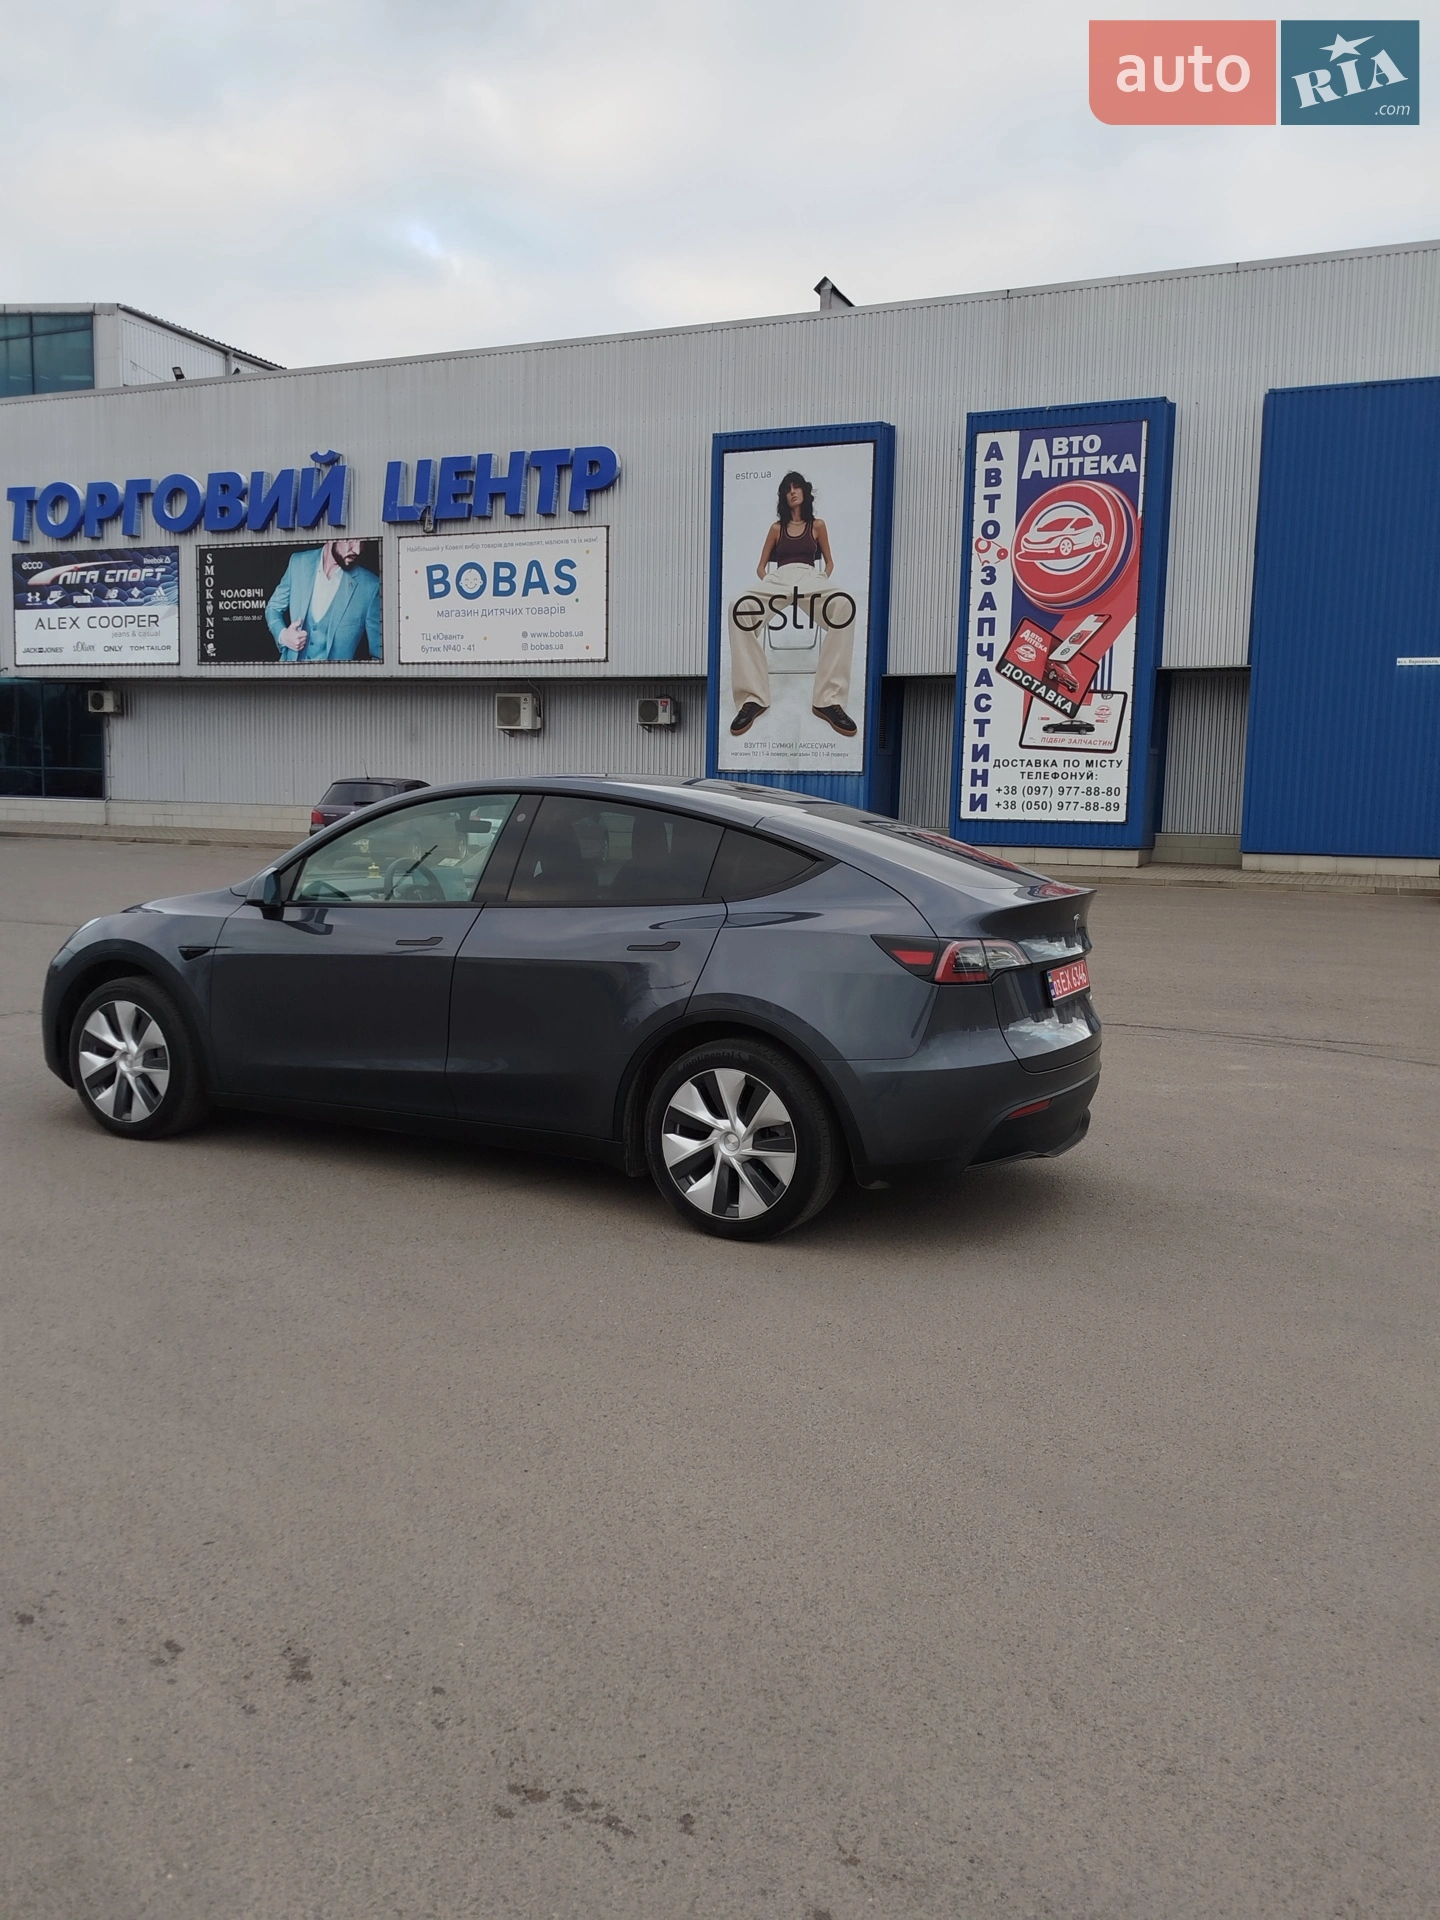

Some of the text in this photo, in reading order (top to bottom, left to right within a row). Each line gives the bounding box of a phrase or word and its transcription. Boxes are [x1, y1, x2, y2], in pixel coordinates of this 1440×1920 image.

[735, 470, 772, 481] estro.ua
[7, 446, 622, 543] ТОРГОВИЙ ЦЕНТР
[445, 543, 463, 551] Ковелі
[21, 561, 43, 570] ecco
[143, 557, 165, 565] Reebok
[58, 567, 166, 585] ЛІГА СПОРТ
[425, 558, 578, 600] BOBAS
[220, 588, 264, 598] ЧОЛОВІЧІ
[218, 600, 266, 610] КОСТЮМИ
[732, 586, 857, 632] estro
[436, 603, 566, 619] магазин дитячих товарів
[34, 614, 160, 630] ALEX COOPER
[111, 630, 130, 639] jeans
[137, 630, 161, 638] casual
[421, 632, 464, 642] ТЦ «Ювант»
[530, 630, 584, 638] www.bobas.ua
[103, 645, 123, 653] ONLY
[420, 644, 442, 654] бутик
[442, 644, 461, 652] №40
[467, 644, 475, 652] 41
[530, 642, 564, 651] bobas.ua
[1000, 662, 1073, 714] ДОСТАВКА
[1067, 738, 1114, 747] ЗАПЧАСТИН
[993, 759, 1123, 769] ДОСТАВКА ПО МІСТУ
[1020, 770, 1098, 780] ТЕЛЕФОНУЙ:
[995, 785, 1121, 798] +38 (097) 977-88-80
[994, 800, 1120, 813] +38 (050) 977-88-89
